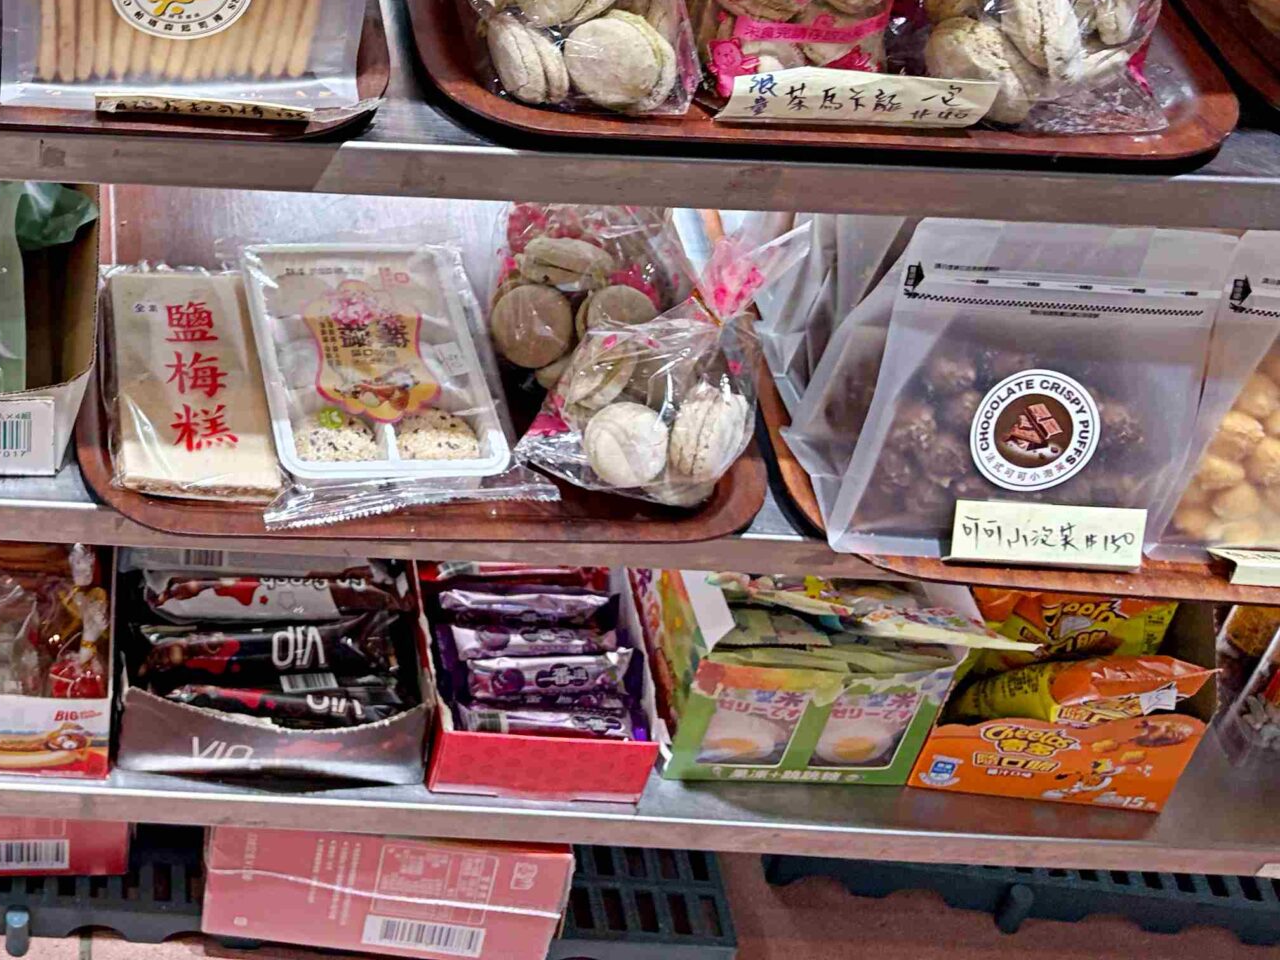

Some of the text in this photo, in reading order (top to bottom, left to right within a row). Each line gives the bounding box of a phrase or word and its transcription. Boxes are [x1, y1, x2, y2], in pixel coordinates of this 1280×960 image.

[165, 300, 239, 453] 鹽梅糕
[979, 379, 1090, 465] CHOCOLATE CRISPY PUFFS
[983, 725, 1074, 751] Cheetos
